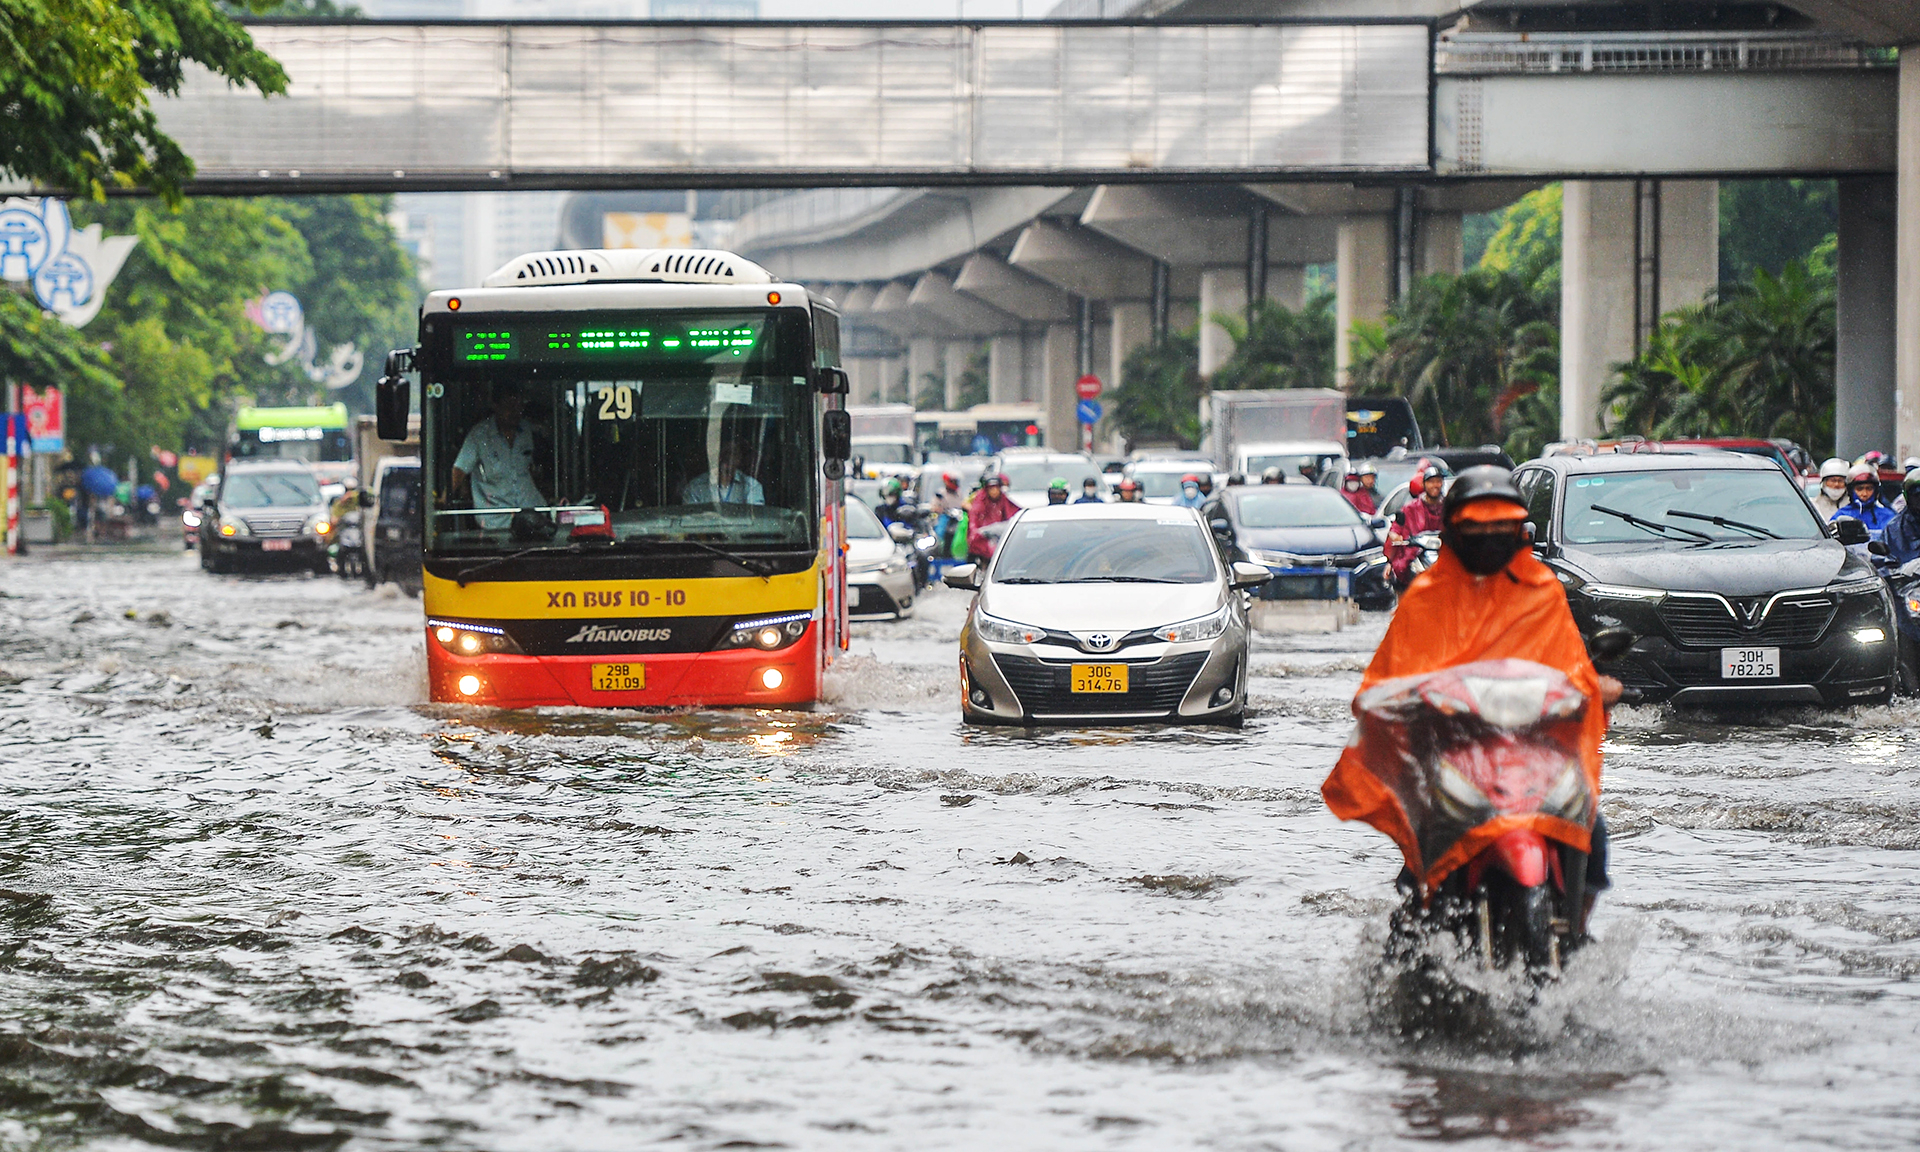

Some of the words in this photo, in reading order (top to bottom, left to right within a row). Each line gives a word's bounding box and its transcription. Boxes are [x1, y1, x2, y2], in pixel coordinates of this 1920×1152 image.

[598, 385, 633, 420] 29
[583, 590, 623, 608] BUS
[630, 590, 650, 607] 10
[666, 589, 686, 606] 10
[1739, 650, 1764, 663] 30H
[607, 664, 630, 676] 29B
[1087, 666, 1112, 678] 30G
[1729, 663, 1774, 676] 782.25
[599, 677, 640, 689] 121.09
[1077, 679, 1122, 691] 314.76
